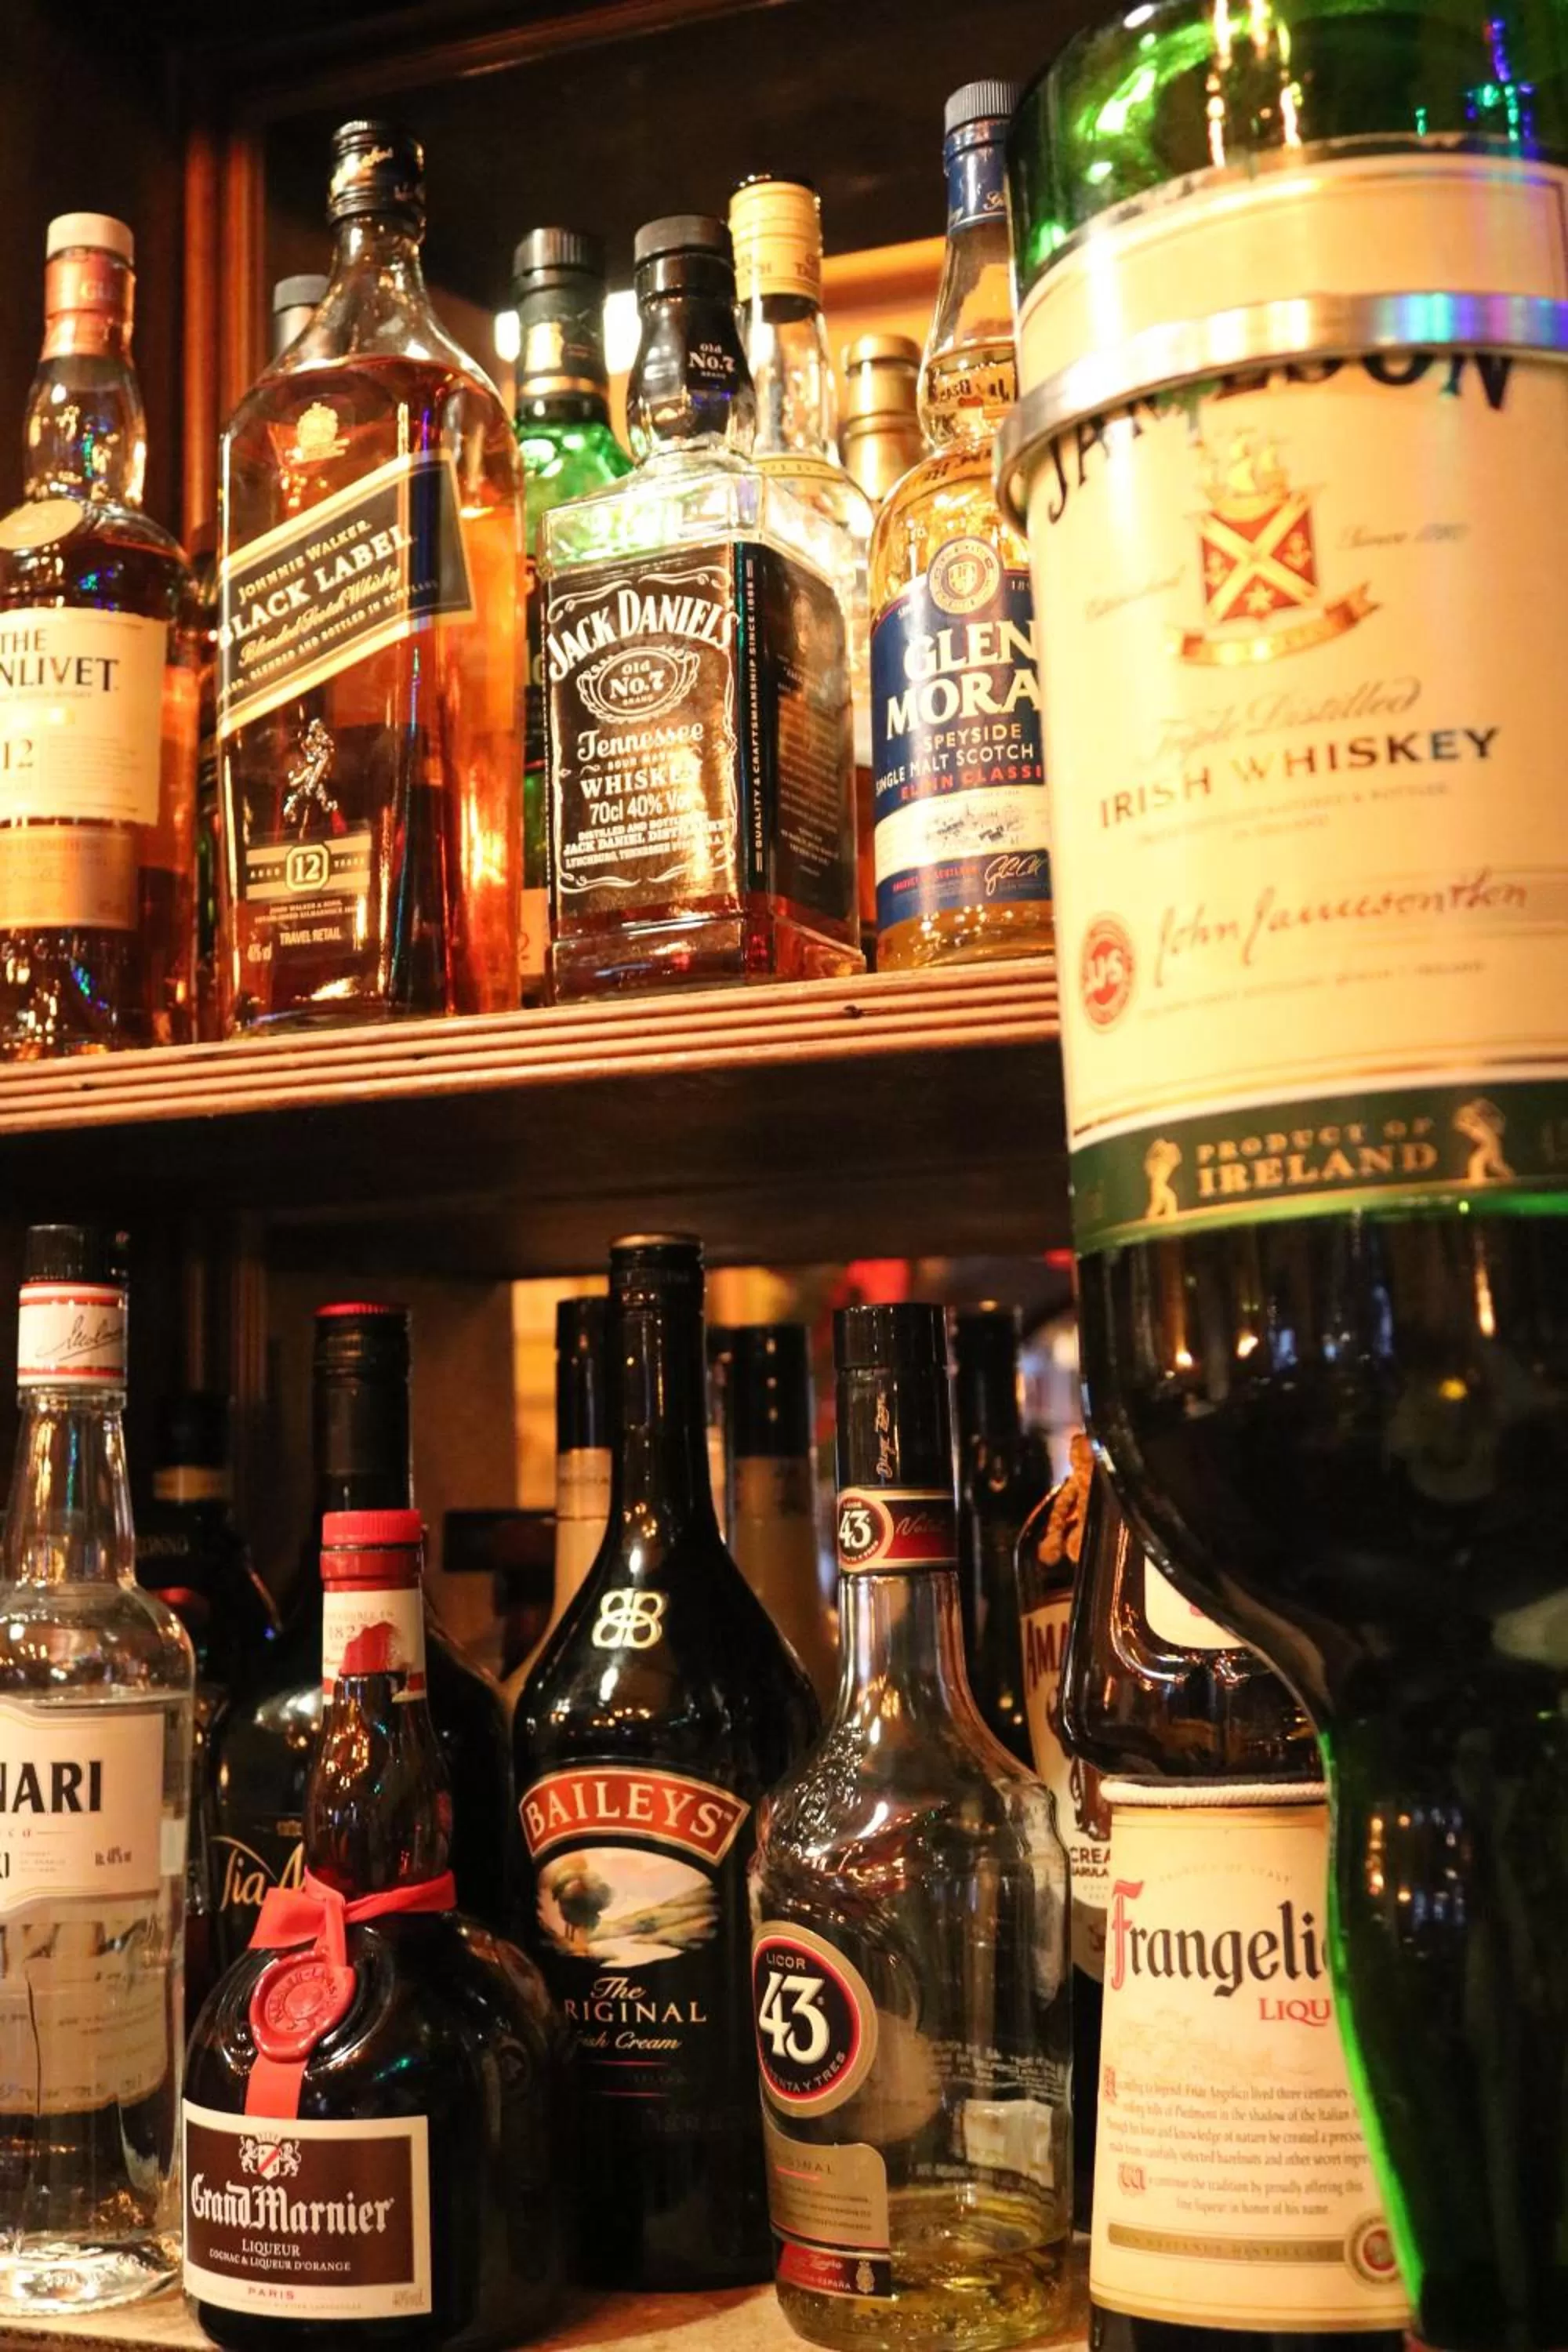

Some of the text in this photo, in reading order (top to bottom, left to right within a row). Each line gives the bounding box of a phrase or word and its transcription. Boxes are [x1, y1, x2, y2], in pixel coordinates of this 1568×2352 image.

[688, 351, 736, 373] No.7
[238, 520, 372, 605] JOHNNIE WALKER
[314, 524, 412, 593] LABEL
[0, 628, 47, 655] THE
[547, 606, 617, 681] JACK
[904, 619, 1040, 682] GLEN
[621, 660, 651, 674] Old
[887, 669, 1042, 741] MORA
[3, 739, 34, 771] 12
[577, 723, 704, 761] Tennessee
[923, 724, 1022, 753] SPEYSIDE
[910, 753, 949, 777] MALT
[956, 742, 1034, 767] SCOTCH
[1100, 767, 1214, 829] IRISH
[1232, 726, 1501, 783] WHISKEY
[590, 799, 624, 826] 70cl
[627, 793, 663, 818] 40%
[294, 854, 321, 883] 12
[1197, 1116, 1434, 1164] PRODUCT OF
[1197, 1142, 1439, 1199] IRELAND
[839, 1510, 871, 1548] 43
[525, 1780, 724, 1841] BAILEYS
[209, 1835, 278, 1912] Tia
[1111, 1879, 1328, 1998] Frangeli
[767, 1953, 806, 1970] LICOR
[590, 1976, 647, 2000] The
[759, 1971, 829, 2064] 43
[615, 2031, 681, 2050] Cream
[814, 2051, 847, 2086] TRES
[191, 2172, 395, 2234] Grand Marnier
[241, 2238, 301, 2257] LIQUEUR
[250, 2257, 293, 2271] LIQUEUR
[293, 2260, 352, 2272] D'ORANGE
[247, 2286, 296, 2301] PARIS
